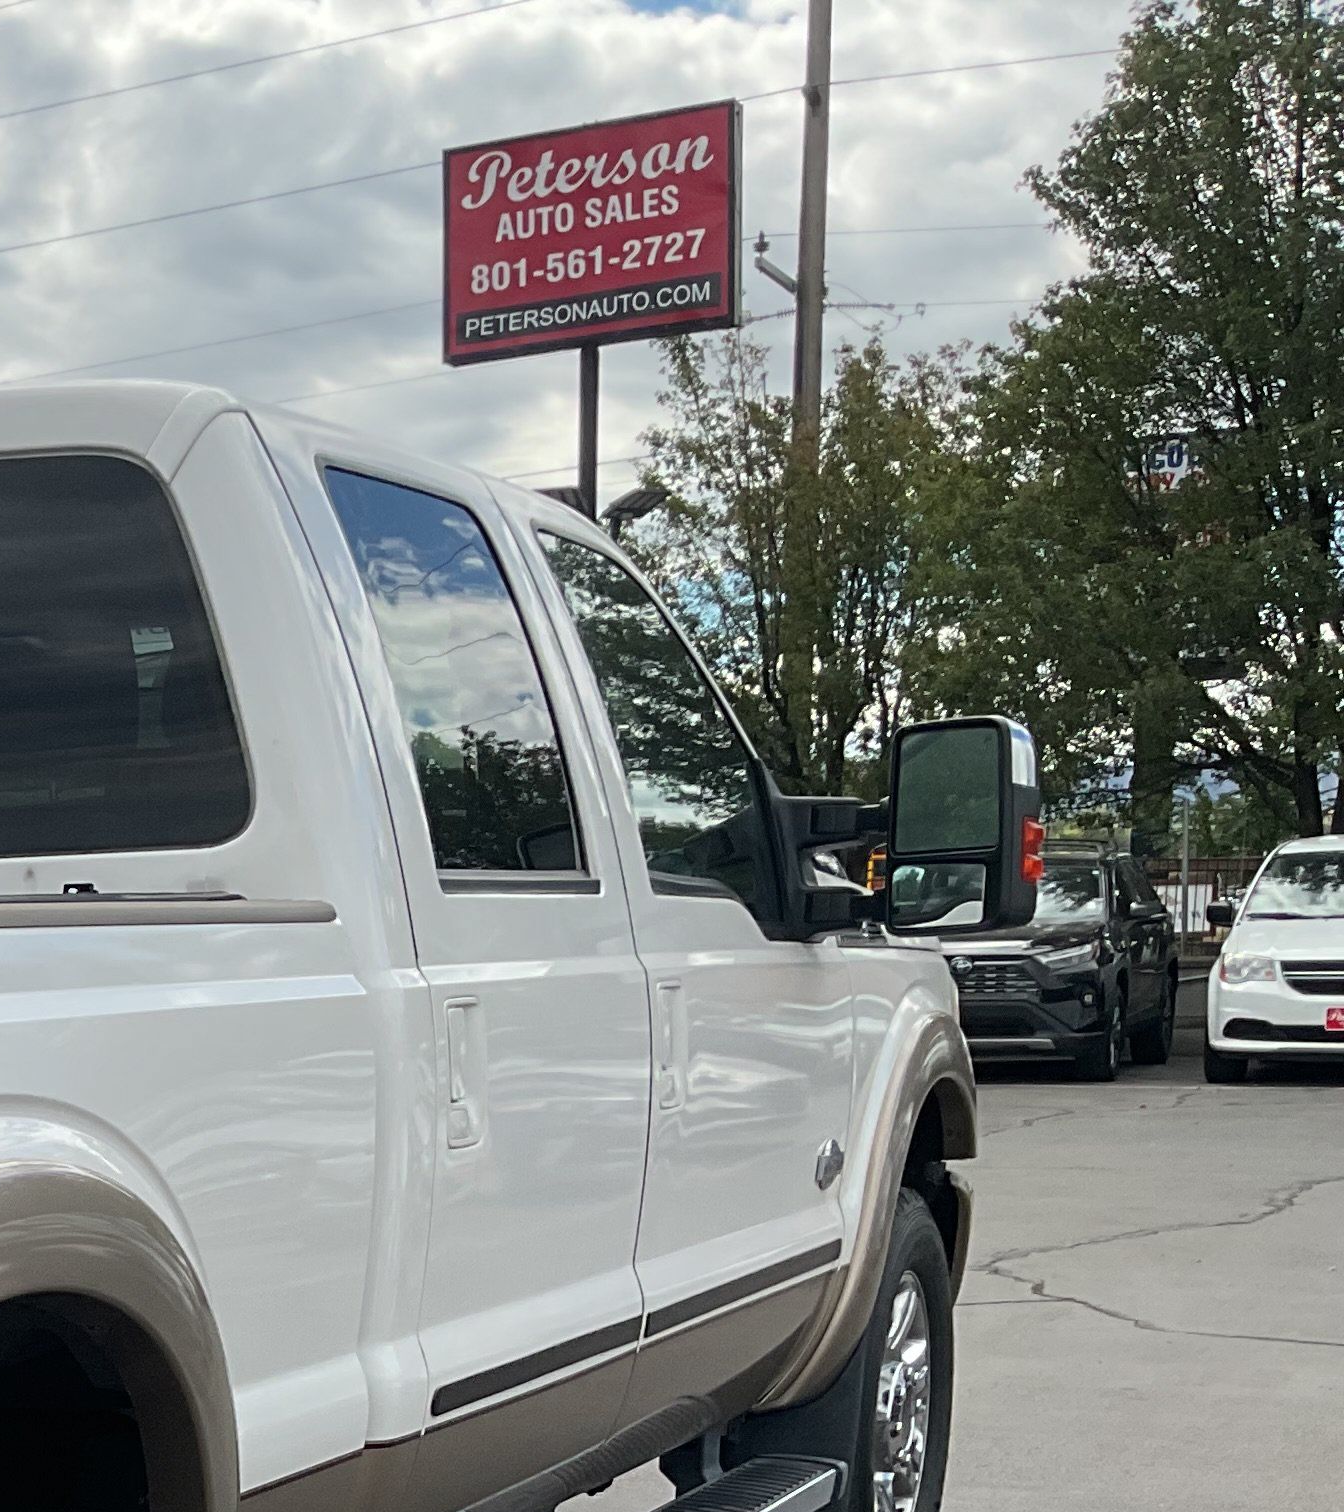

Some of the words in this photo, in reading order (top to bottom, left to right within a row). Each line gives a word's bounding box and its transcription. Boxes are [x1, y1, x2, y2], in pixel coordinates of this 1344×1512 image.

[462, 135, 714, 210] Peterson
[495, 202, 575, 243] AUTO
[584, 184, 679, 228] SALES
[471, 228, 706, 295] 801-561-2727
[465, 281, 710, 338] PETERSONAUTO.COM
